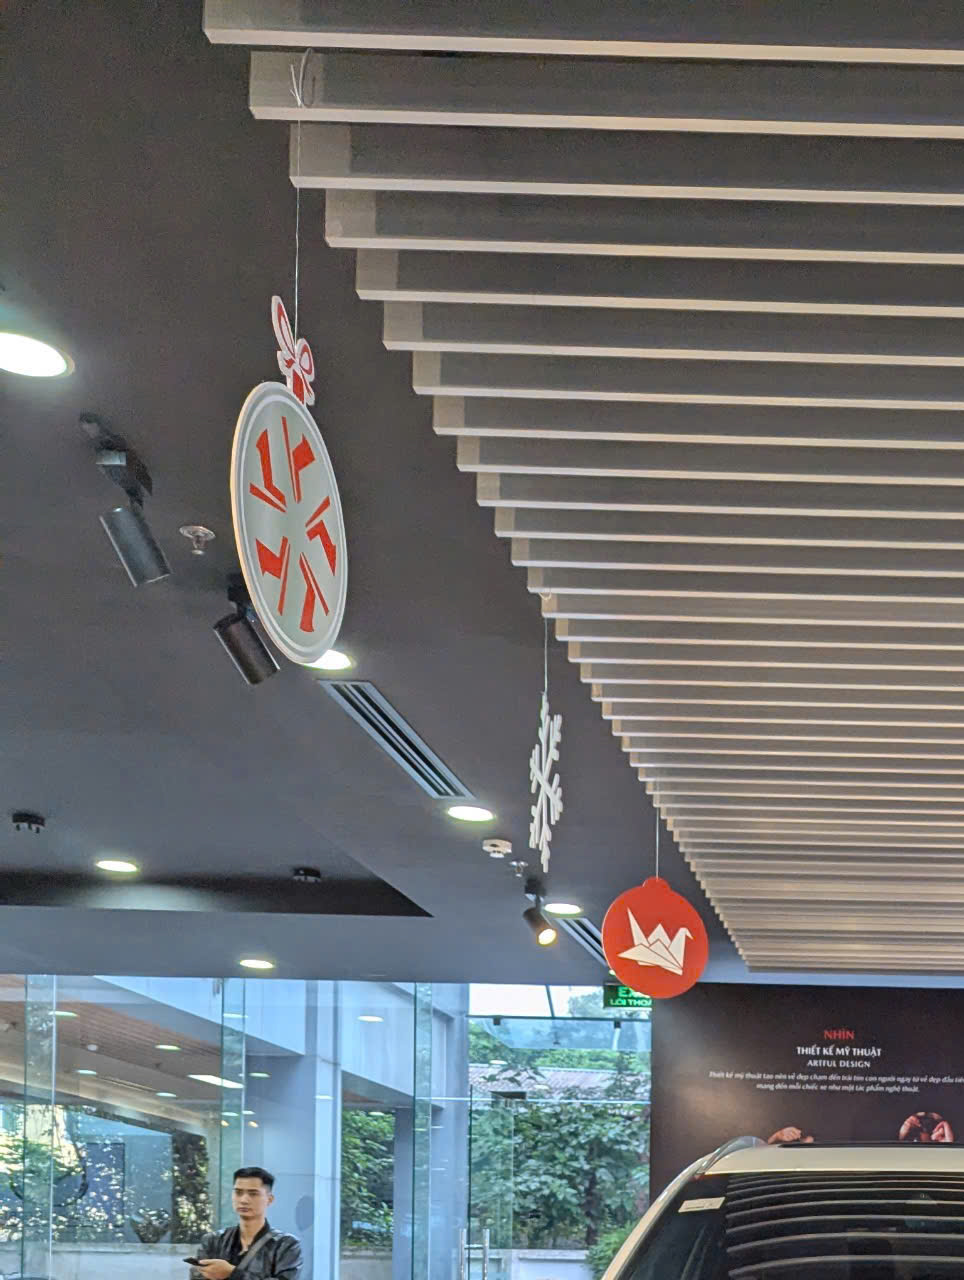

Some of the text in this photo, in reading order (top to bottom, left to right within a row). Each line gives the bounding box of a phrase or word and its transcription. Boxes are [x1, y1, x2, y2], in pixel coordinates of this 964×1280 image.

[796, 1044, 821, 1056] THIẾT
[822, 1044, 835, 1056] KẾ
[852, 1046, 882, 1058] THUẬT
[807, 1060, 871, 1069] ARTFUL DESIGN
